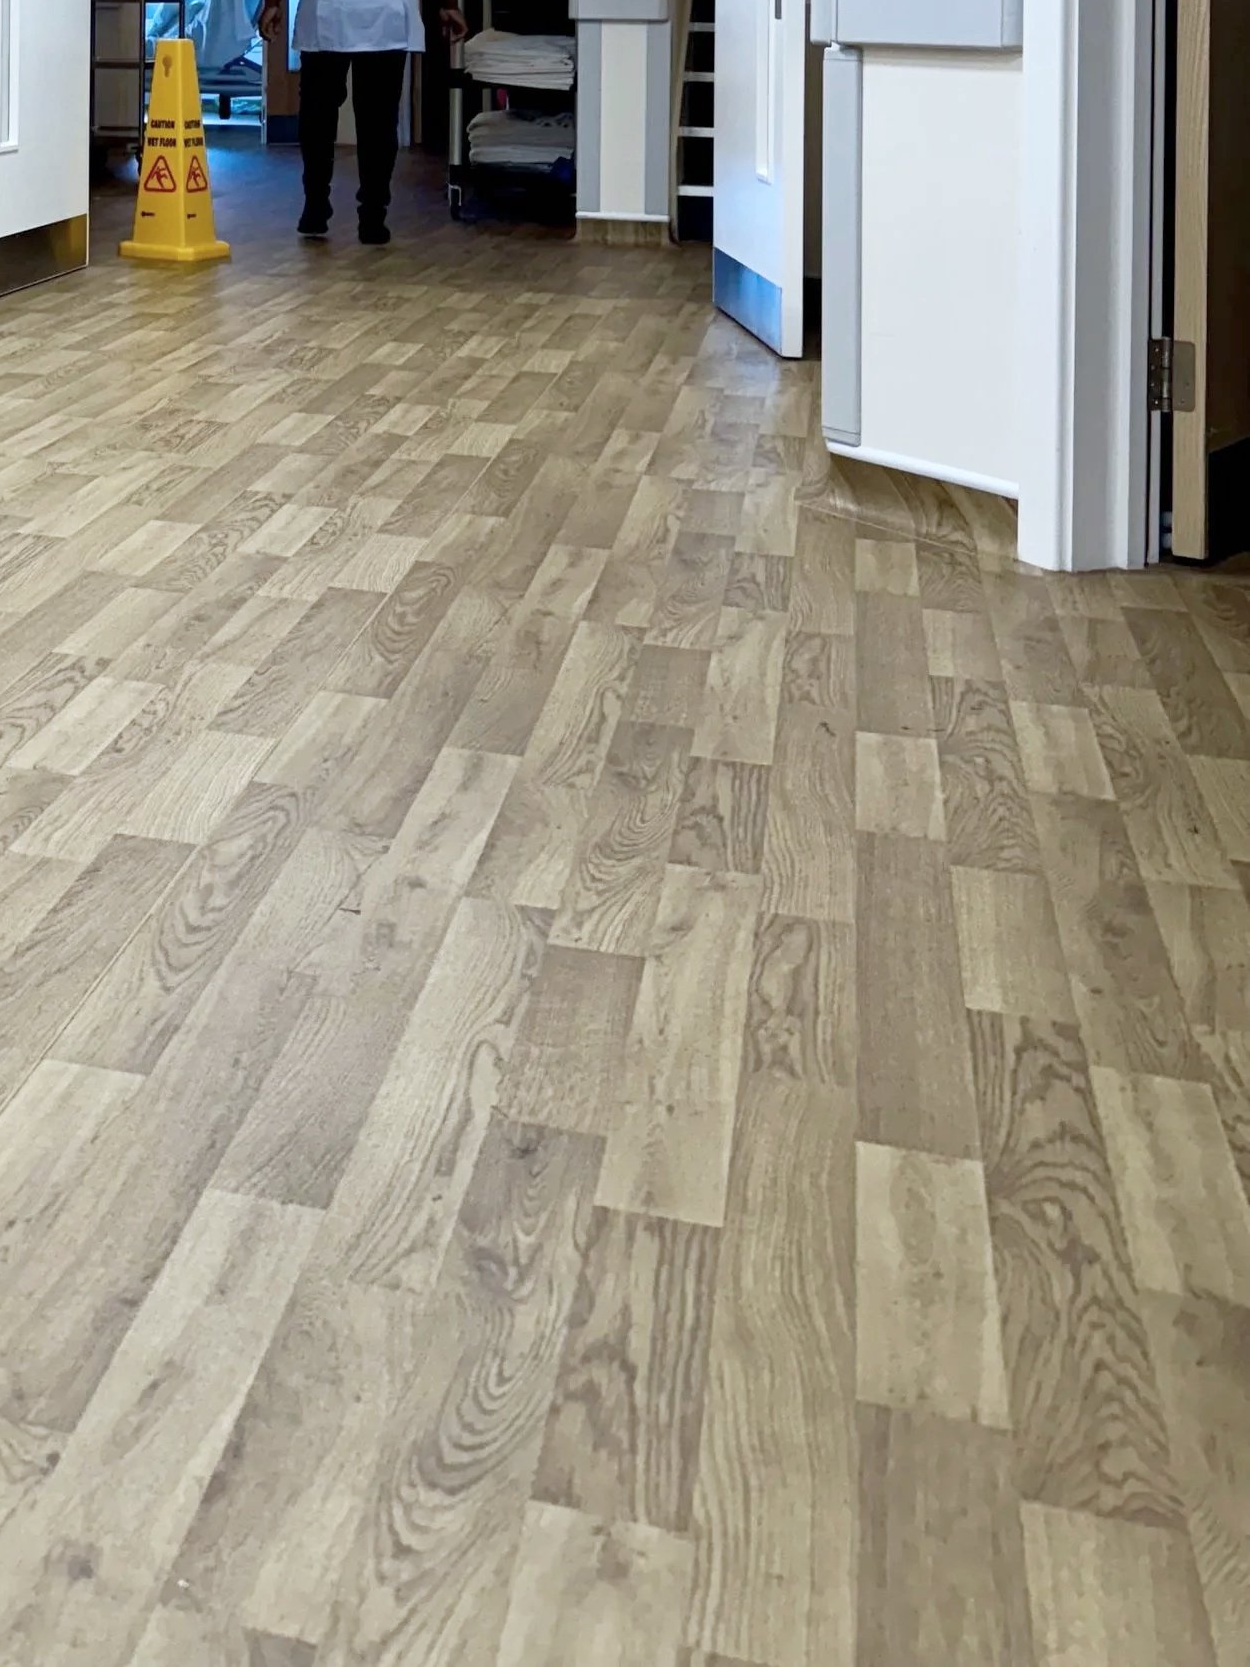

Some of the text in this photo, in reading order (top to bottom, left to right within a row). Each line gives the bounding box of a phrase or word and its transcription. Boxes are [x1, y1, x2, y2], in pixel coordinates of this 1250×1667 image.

[151, 119, 175, 129] CAUTION
[147, 137, 177, 147] WET FLOOR
